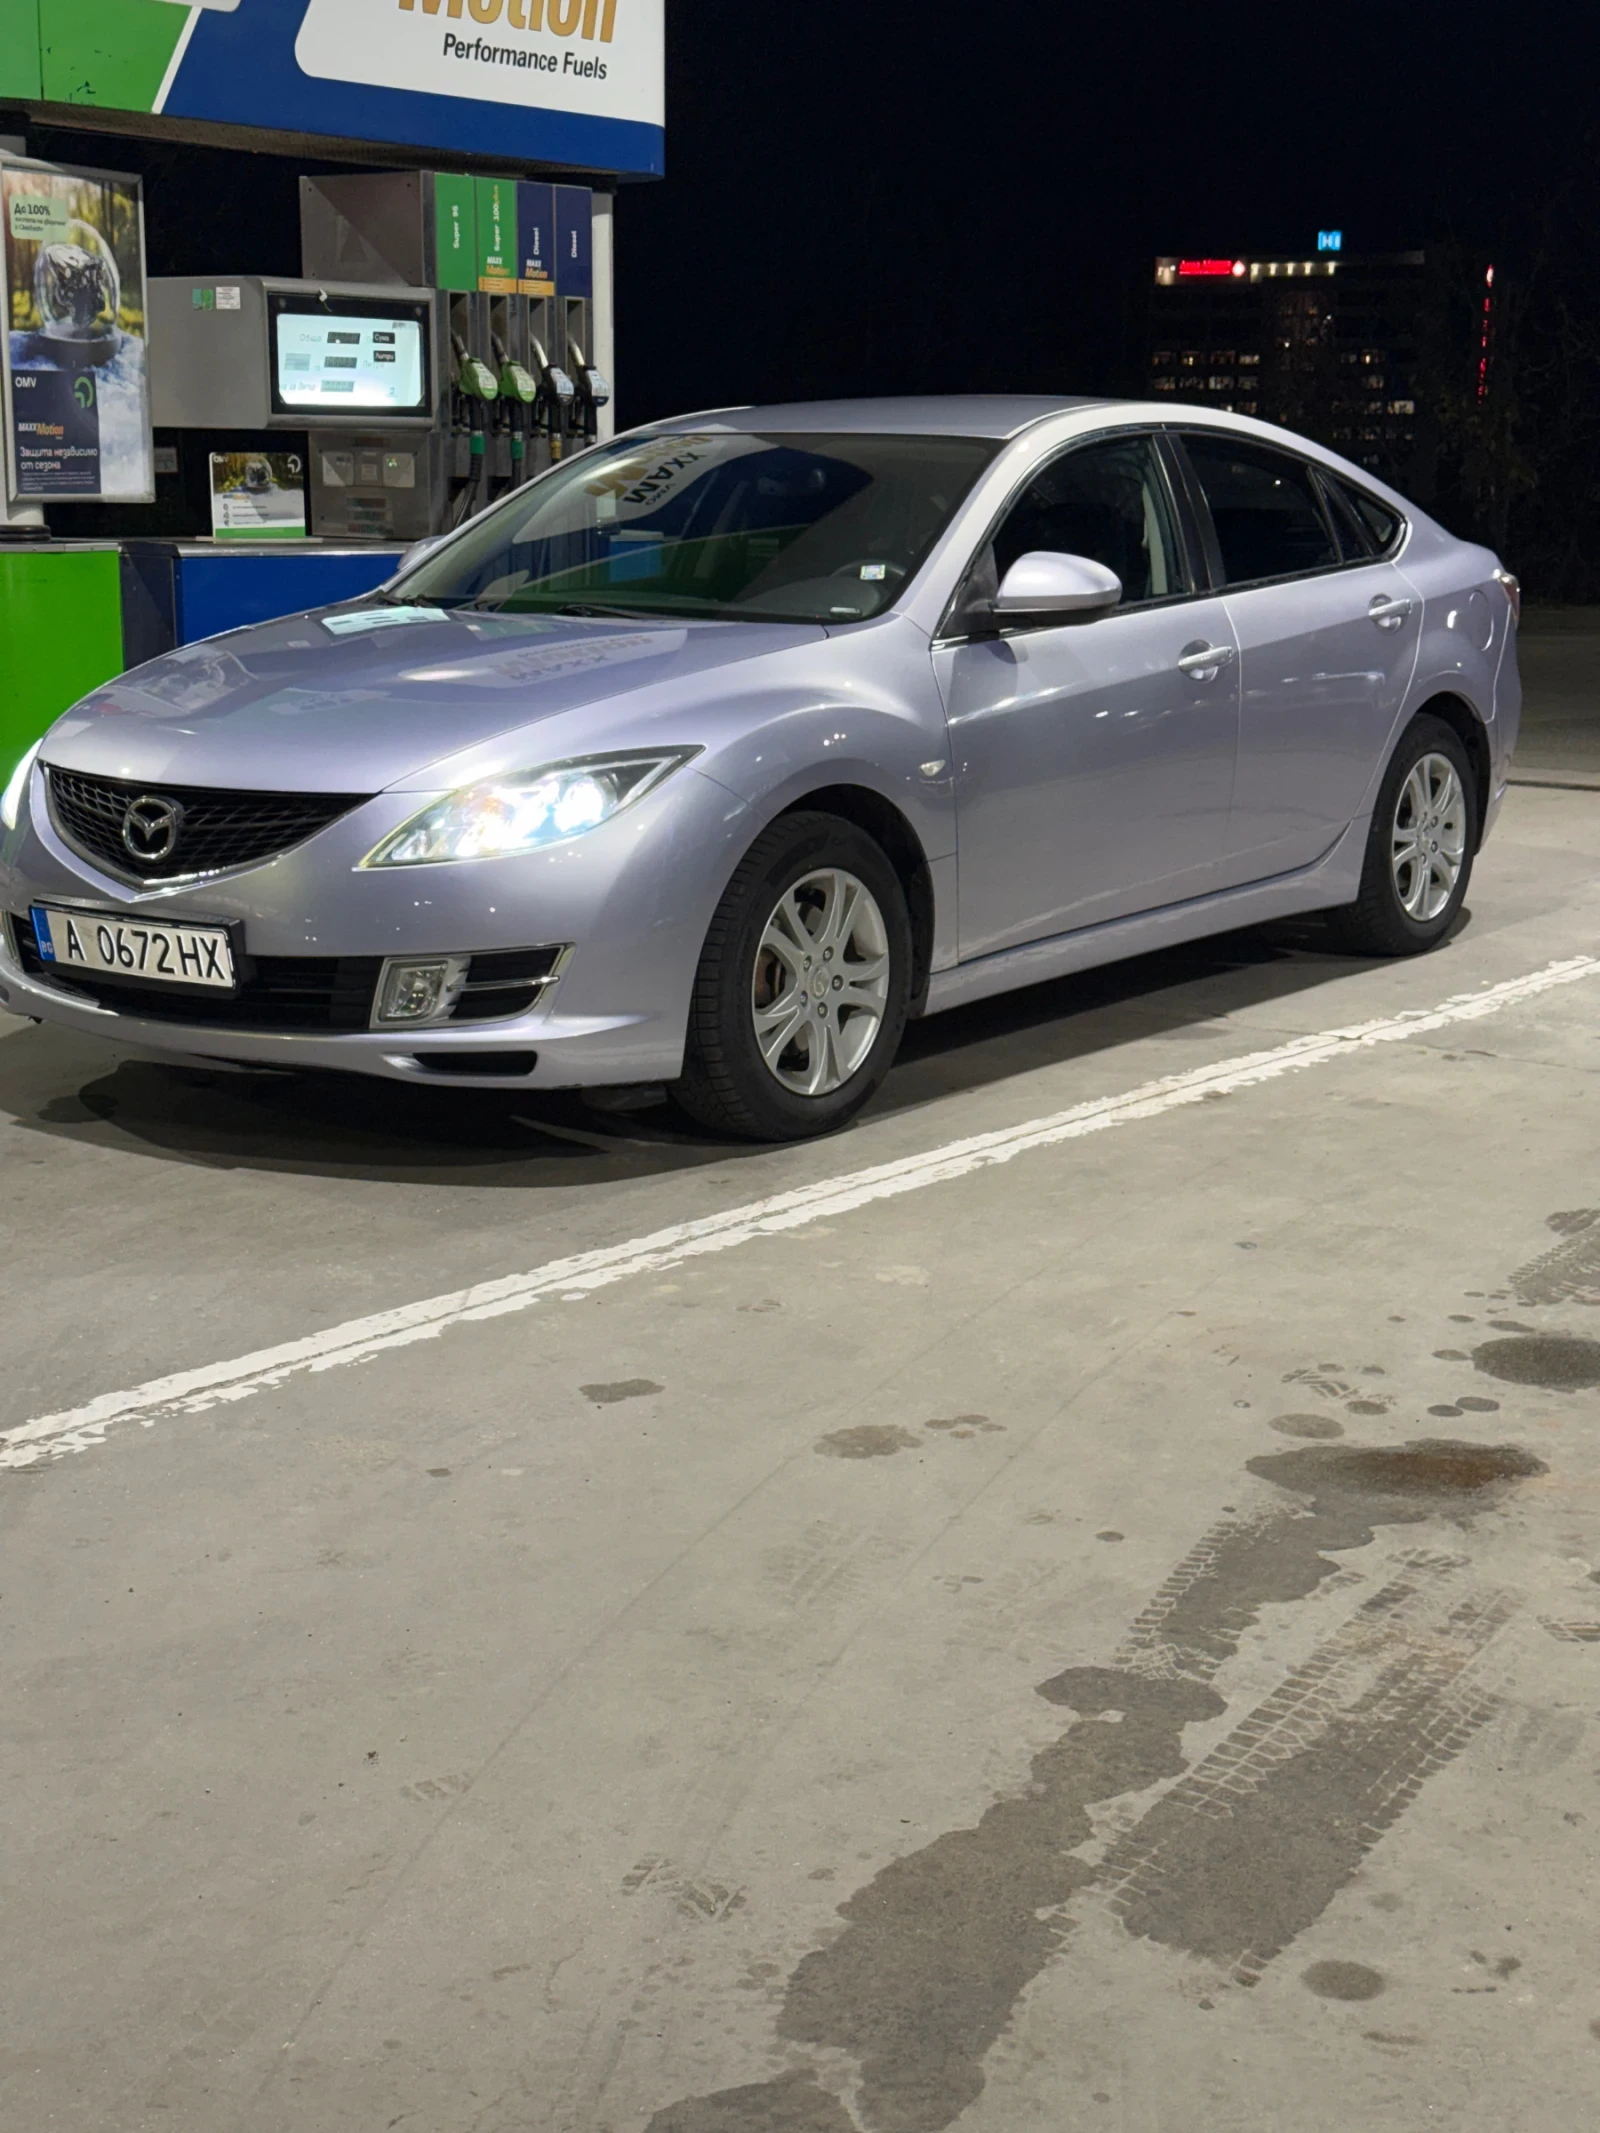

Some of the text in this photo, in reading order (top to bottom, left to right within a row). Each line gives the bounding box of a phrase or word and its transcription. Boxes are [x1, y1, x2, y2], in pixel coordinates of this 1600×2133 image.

[443, 32, 607, 80] Performance Fuels
[14, 203, 51, 216] До 100%
[452, 221, 461, 249] Super
[493, 224, 502, 252] Super
[487, 256, 503, 265] MAXX
[526, 259, 542, 267] MAXX
[15, 376, 37, 388] OMV
[18, 422, 65, 436] MAXX Motion
[20, 446, 98, 459] Защита независимо
[20, 461, 62, 472] от сезона
[67, 918, 87, 962] A
[40, 940, 54, 954] BG
